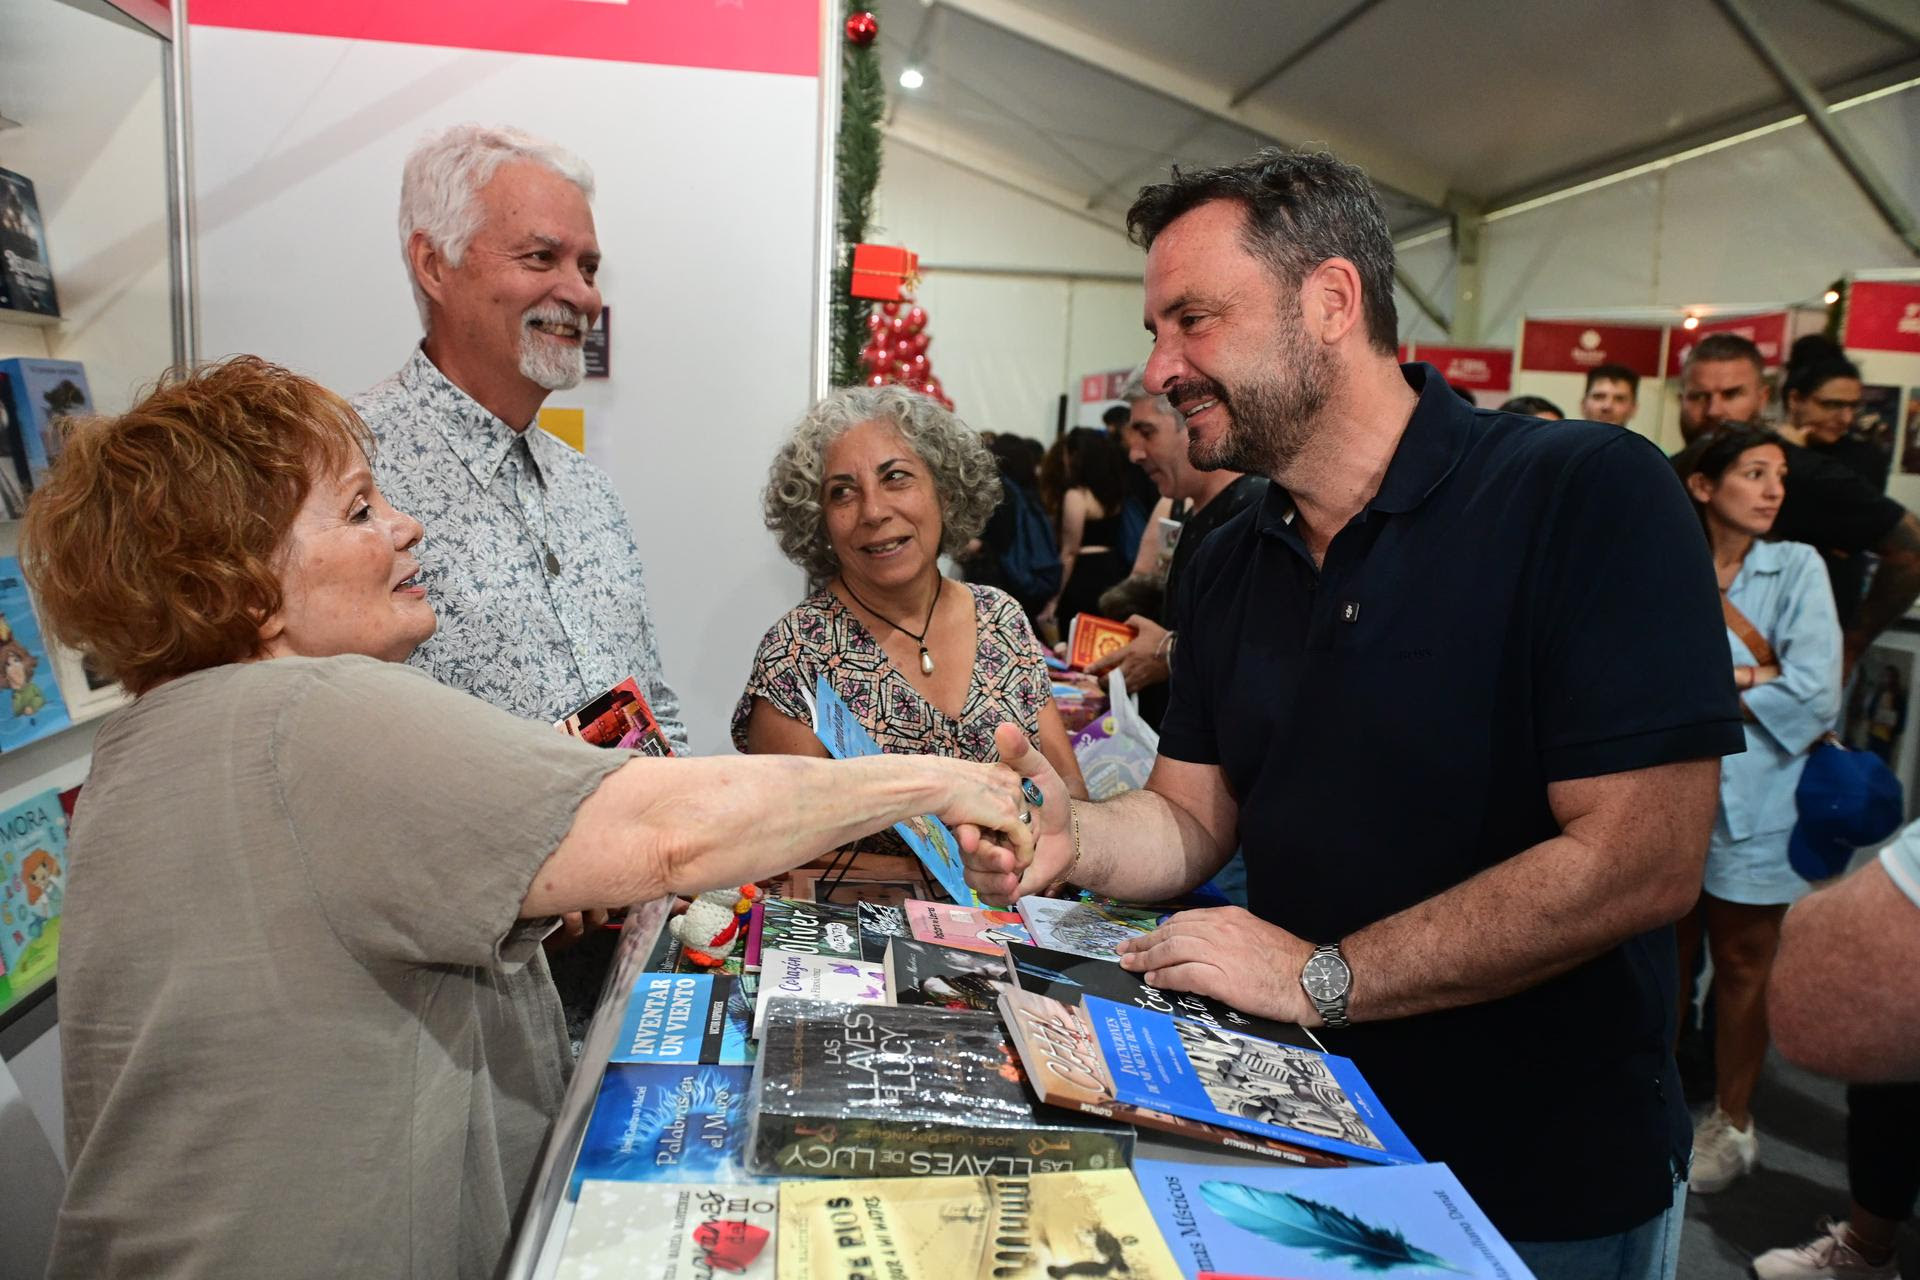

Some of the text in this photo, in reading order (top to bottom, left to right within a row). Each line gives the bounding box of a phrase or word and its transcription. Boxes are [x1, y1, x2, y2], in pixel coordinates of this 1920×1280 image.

[0, 807, 48, 844] MORA
[775, 909, 819, 954] Oliver
[779, 956, 808, 991] Corazón
[630, 979, 673, 1055] INVENTAR
[664, 978, 697, 1032] VIENTO
[658, 1034, 686, 1057] UN
[824, 1039, 841, 1065] LAS
[844, 1012, 880, 1107] LLAVES
[878, 1025, 917, 1092] LUCY
[656, 1075, 695, 1167] Palabras en
[701, 1090, 730, 1149] el Muro
[784, 1144, 1074, 1177] LAS LLAVES DE LUCY
[1164, 1175, 1202, 1239] Místicos
